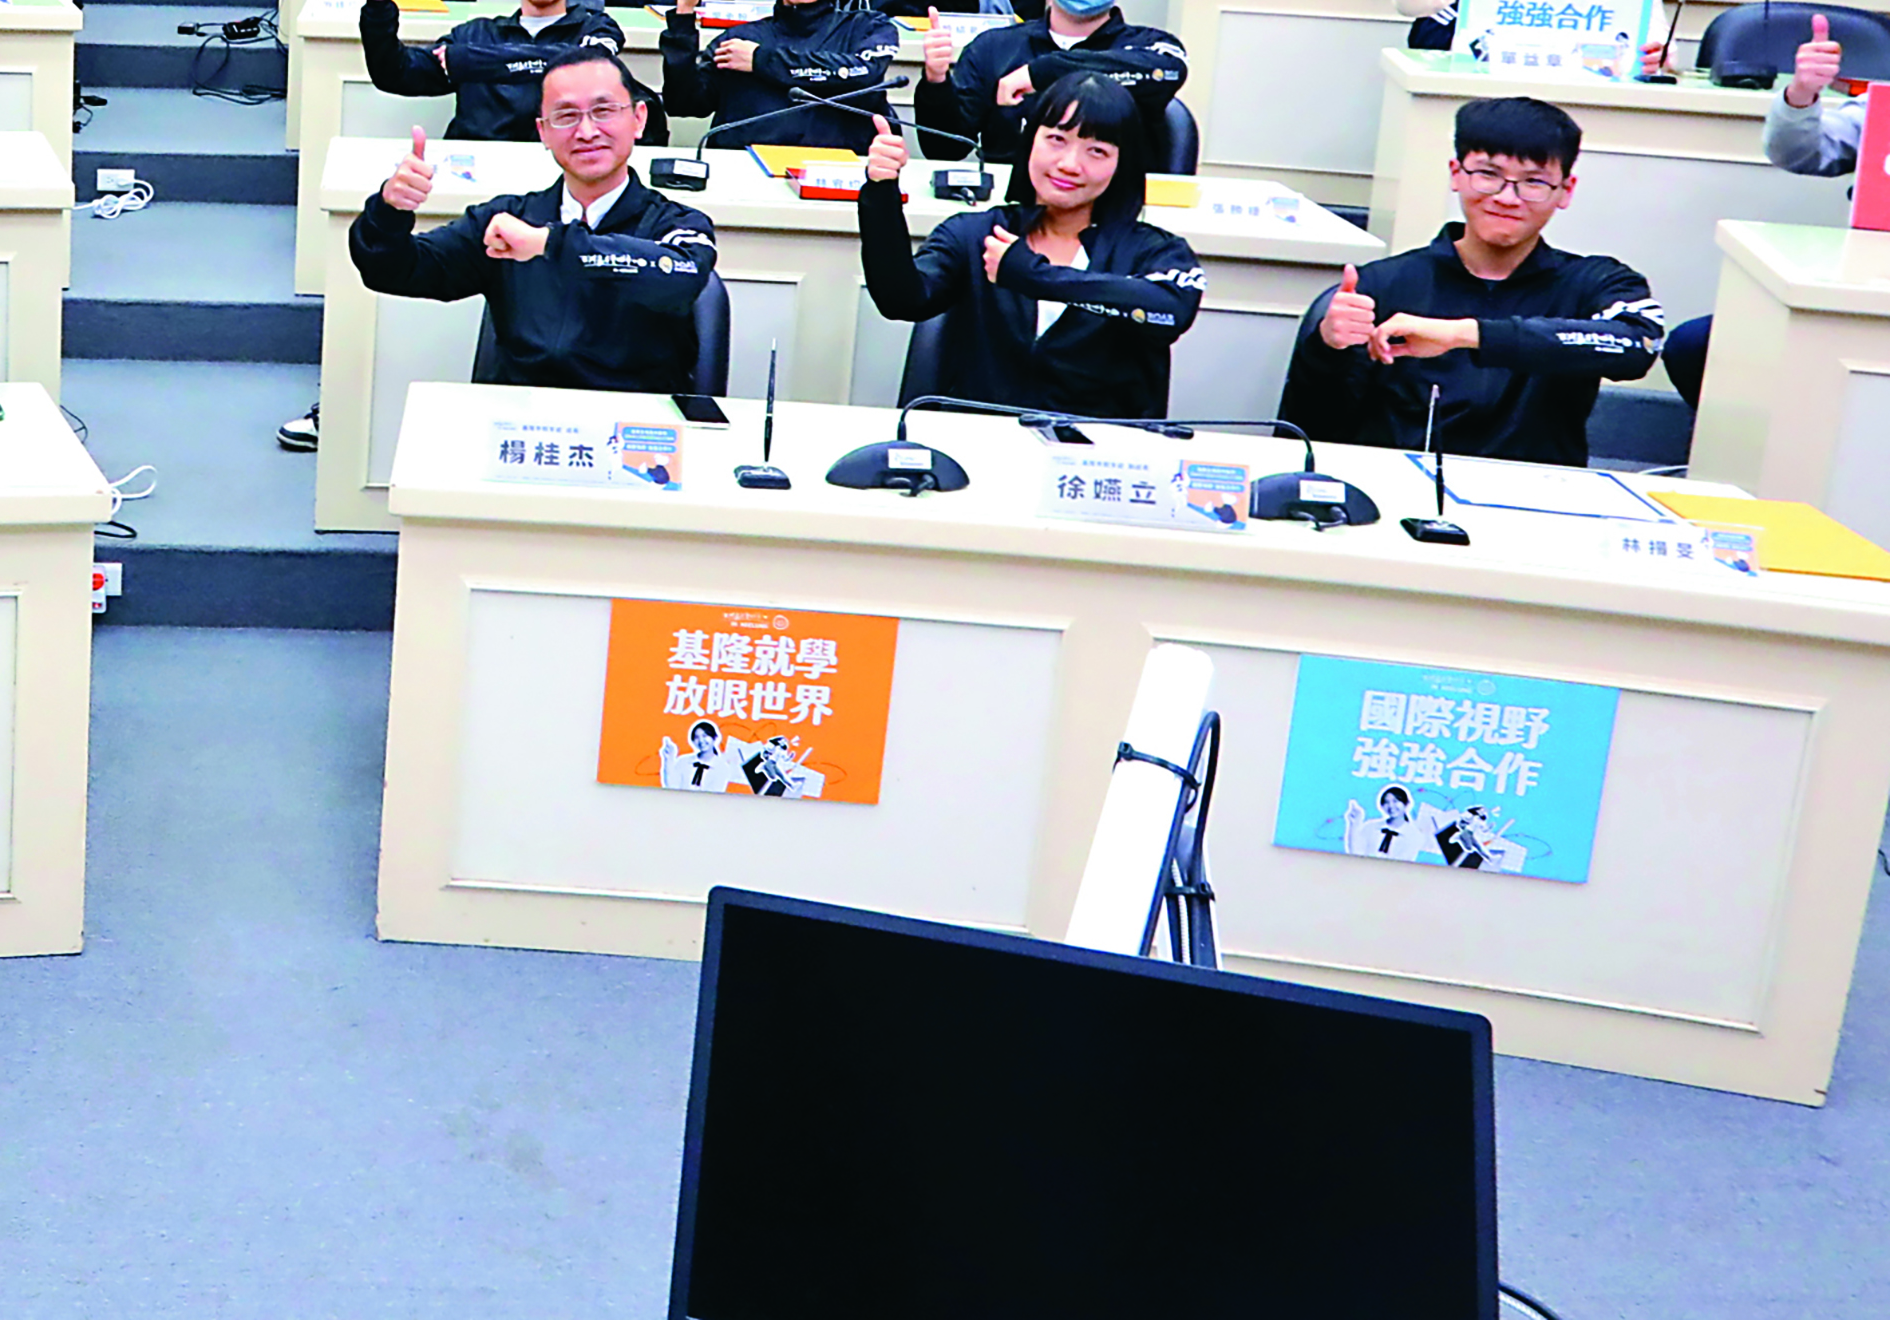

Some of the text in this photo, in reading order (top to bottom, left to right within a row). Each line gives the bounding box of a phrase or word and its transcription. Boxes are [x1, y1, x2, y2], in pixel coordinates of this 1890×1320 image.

[1495, 0, 1615, 32] 強強合作
[498, 439, 595, 468] 楊桂杰
[1057, 474, 1157, 505] 徐嬿立
[667, 628, 839, 680] 基隆就學
[662, 674, 834, 726] 放眼世界
[1359, 688, 1552, 750] 國際視野
[1351, 735, 1544, 797] 強強合作
